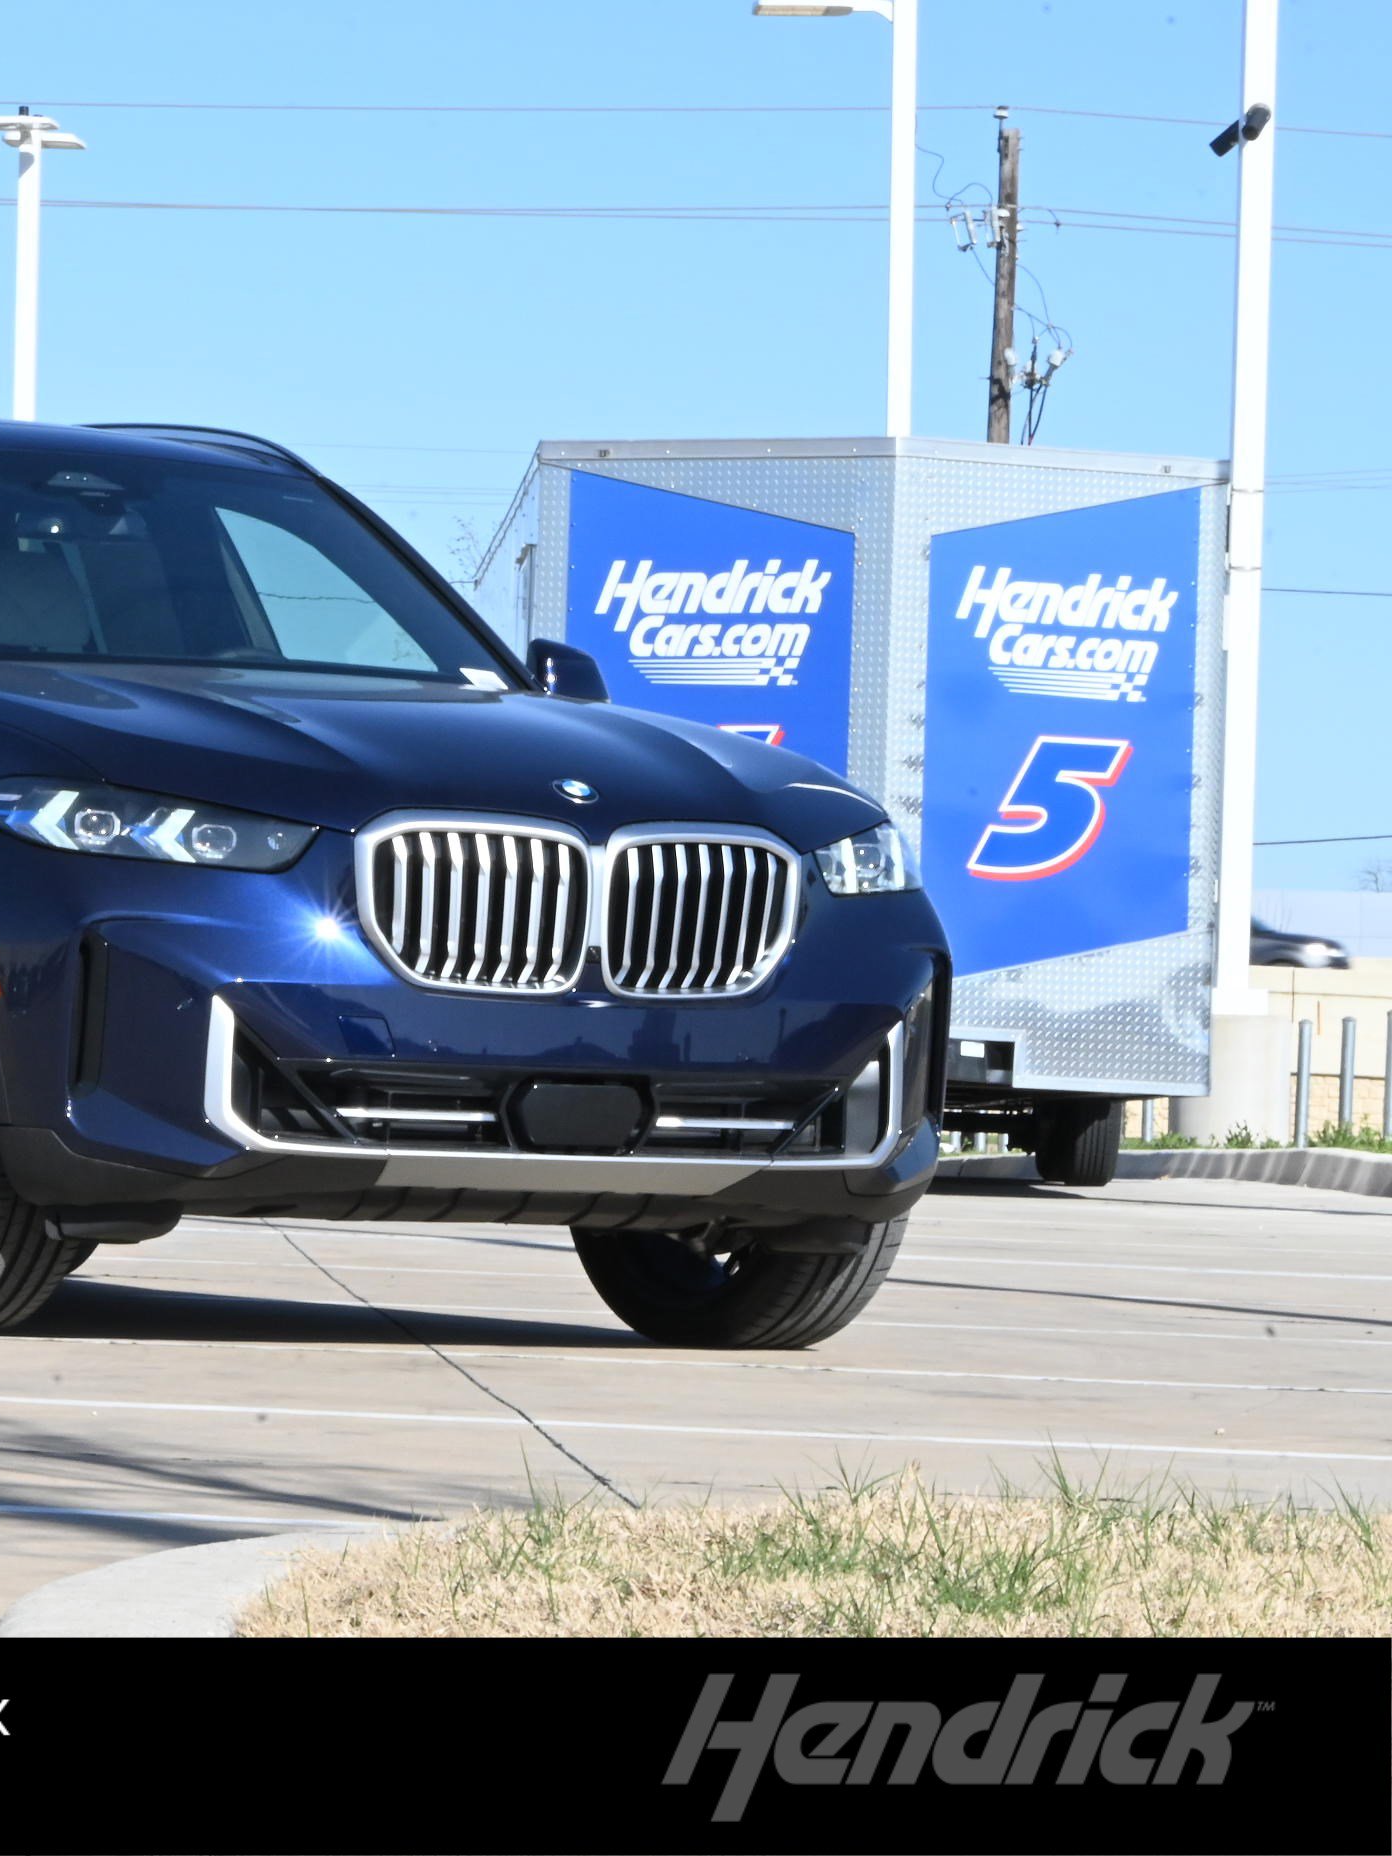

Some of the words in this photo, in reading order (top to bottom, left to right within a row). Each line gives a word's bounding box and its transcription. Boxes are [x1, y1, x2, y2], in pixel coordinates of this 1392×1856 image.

[594, 559, 832, 632] Hendrick
[955, 565, 1179, 638] Hendrick
[629, 614, 811, 657] Cars.com
[988, 623, 1159, 674] Cars.com
[966, 735, 1134, 882] 5
